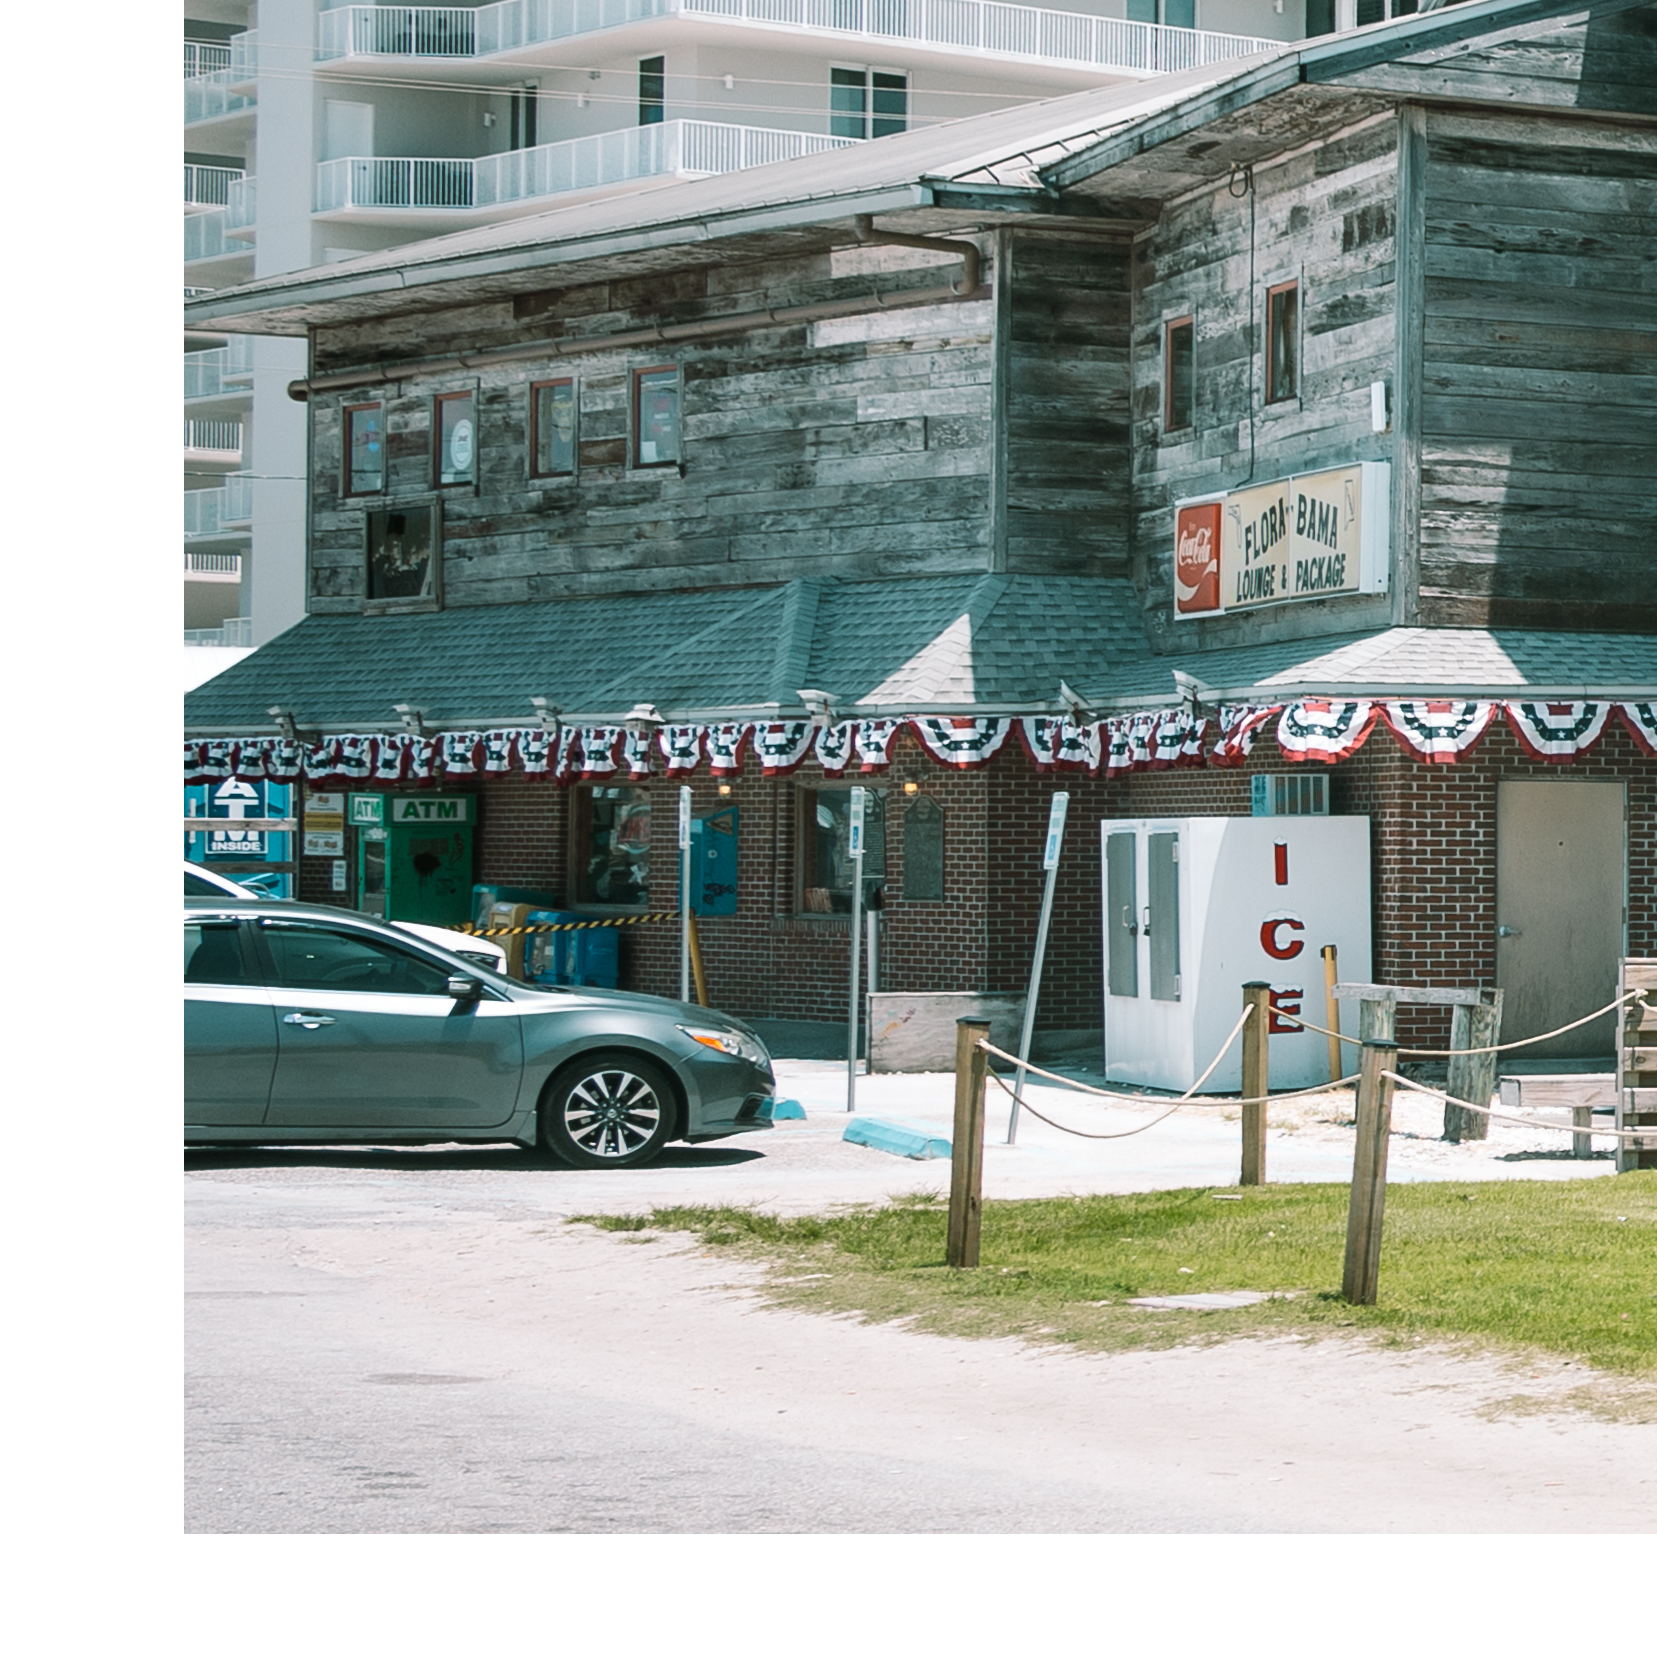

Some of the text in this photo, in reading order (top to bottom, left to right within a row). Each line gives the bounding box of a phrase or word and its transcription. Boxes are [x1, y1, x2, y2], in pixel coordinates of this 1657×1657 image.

[1236, 553, 1347, 603] LOUNGE & PACKAGE
[355, 799, 381, 819] ATM
[402, 800, 458, 819] ATM
[211, 841, 262, 851] INSIDE
[1260, 835, 1305, 1034] ICE
